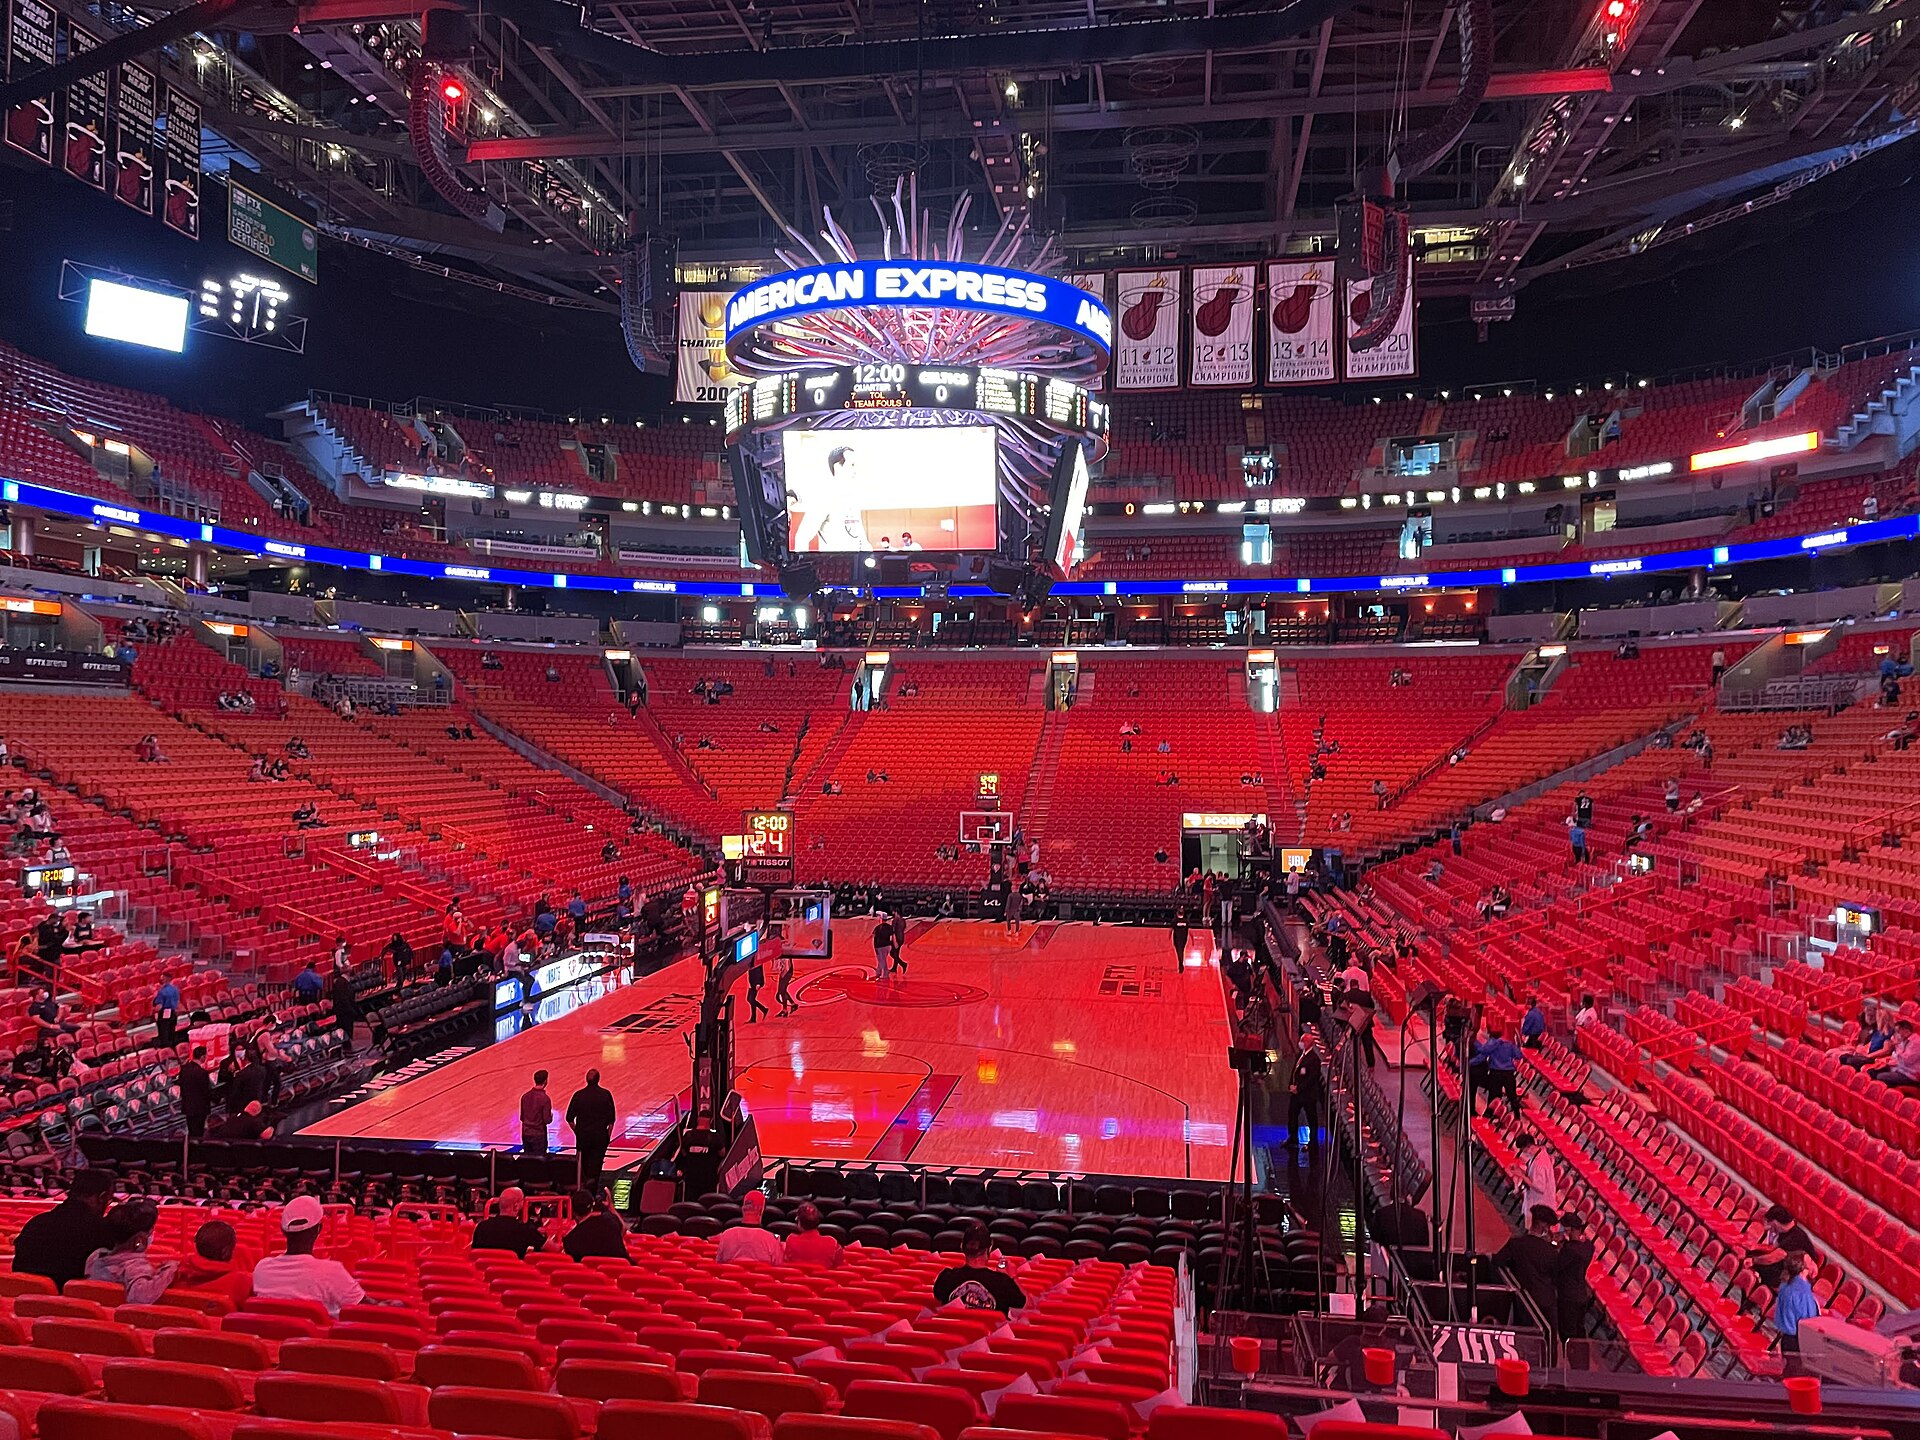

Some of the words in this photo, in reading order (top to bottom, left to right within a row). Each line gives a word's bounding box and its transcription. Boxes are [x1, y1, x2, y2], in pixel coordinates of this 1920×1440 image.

[246, 195, 262, 212] FTX
[232, 216, 252, 235] LEED
[252, 227, 276, 248] GOLD
[729, 269, 863, 332] AMERICAN
[876, 267, 1047, 313] EXPRESS
[1273, 341, 1292, 360] 13
[1310, 339, 1329, 358] 14
[1387, 333, 1409, 353] 20
[1121, 348, 1138, 366] 11
[1155, 346, 1174, 365] 12
[1196, 344, 1214, 363] 12
[1230, 343, 1249, 361] 13
[853, 364, 905, 384] 12:00
[1272, 367, 1330, 378] CHAMPIONS
[1350, 361, 1410, 374] CHAMPIONS
[1120, 374, 1175, 385] CHAMPIONS
[1194, 371, 1250, 381] CHAMPIONS
[696, 386, 741, 401] 200
[853, 383, 892, 392] QUARTER
[935, 385, 948, 403] 0
[813, 388, 825, 405] 0
[853, 400, 875, 408] TEAM
[876, 399, 903, 408] FOULS
[1126, 503, 1135, 515] 0
[980, 783, 996, 795] 24
[754, 815, 788, 831] 12:00
[1204, 816, 1250, 826] DOORD
[754, 830, 783, 854] 24
[757, 859, 790, 867] TISSOT
[42, 869, 65, 882] 12:00
[360, 1045, 476, 1091] HEAT.COM
[1457, 1327, 1519, 1365] LET'S
